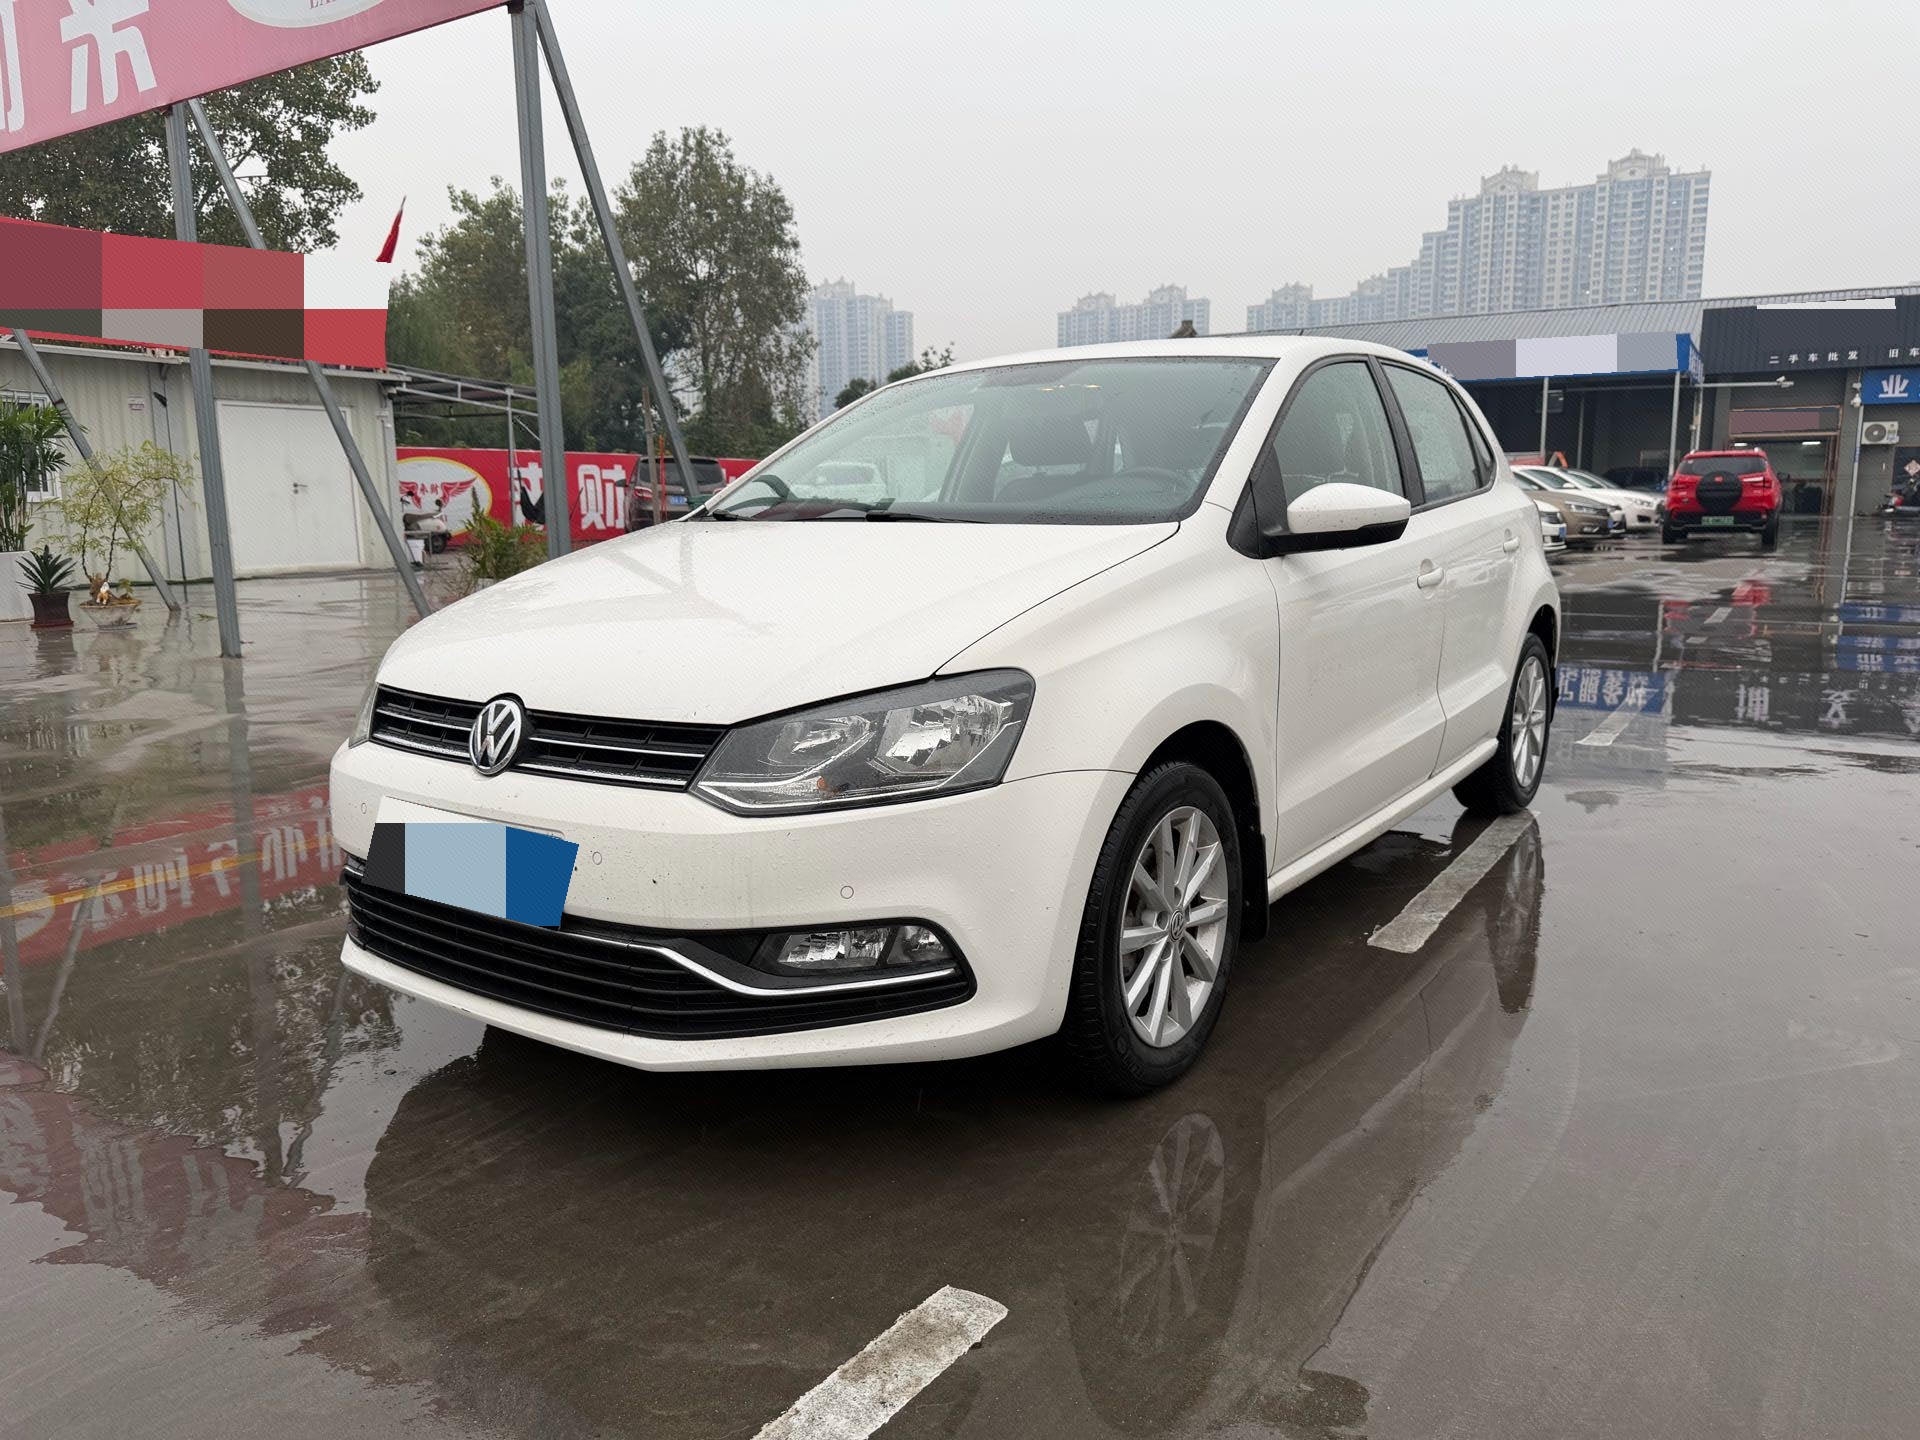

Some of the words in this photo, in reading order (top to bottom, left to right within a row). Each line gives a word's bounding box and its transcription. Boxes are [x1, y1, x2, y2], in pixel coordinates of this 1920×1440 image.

[1769, 350, 1859, 364] 二手车批发
